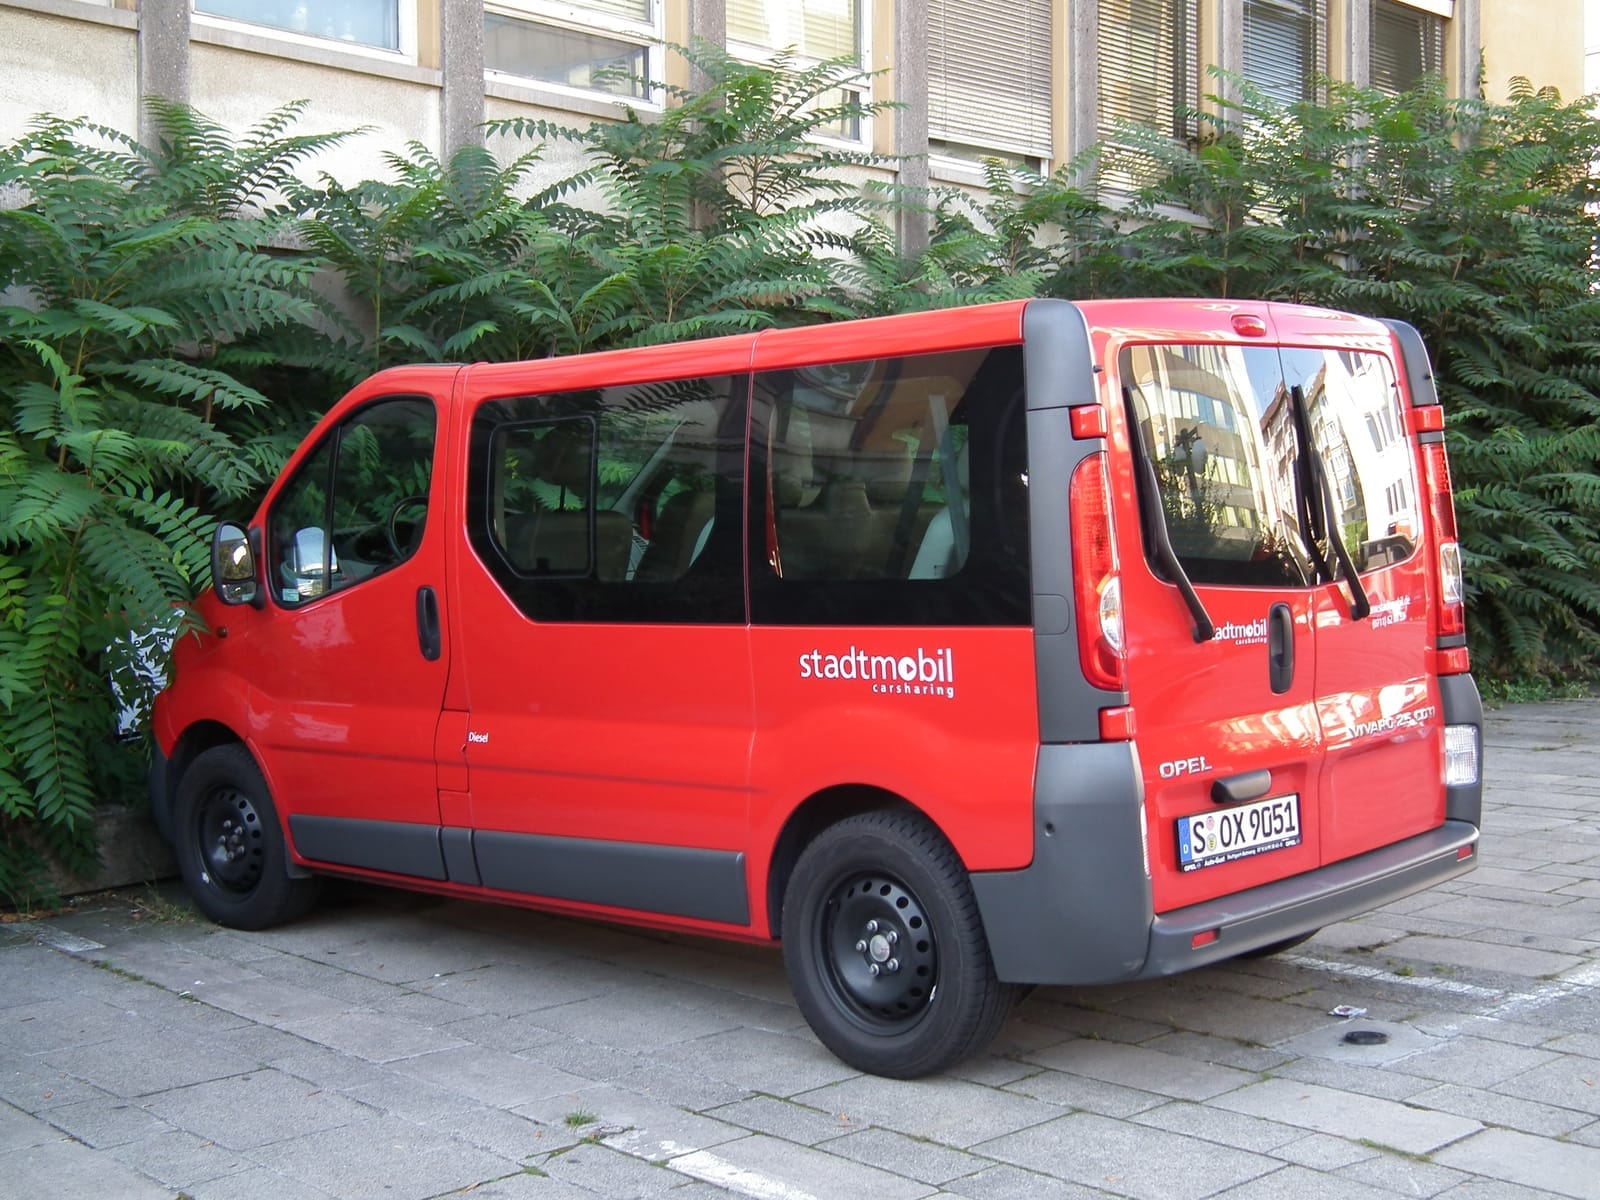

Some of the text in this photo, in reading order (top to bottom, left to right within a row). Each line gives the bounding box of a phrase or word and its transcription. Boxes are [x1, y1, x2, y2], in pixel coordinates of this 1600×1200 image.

[1211, 618, 1267, 641] adtmobil
[799, 645, 953, 683] stadtmobil
[872, 683, 955, 699] carsharing
[468, 731, 489, 743] Diesel
[1159, 756, 1213, 779] OPEL
[1193, 801, 1296, 853] S OX 9051
